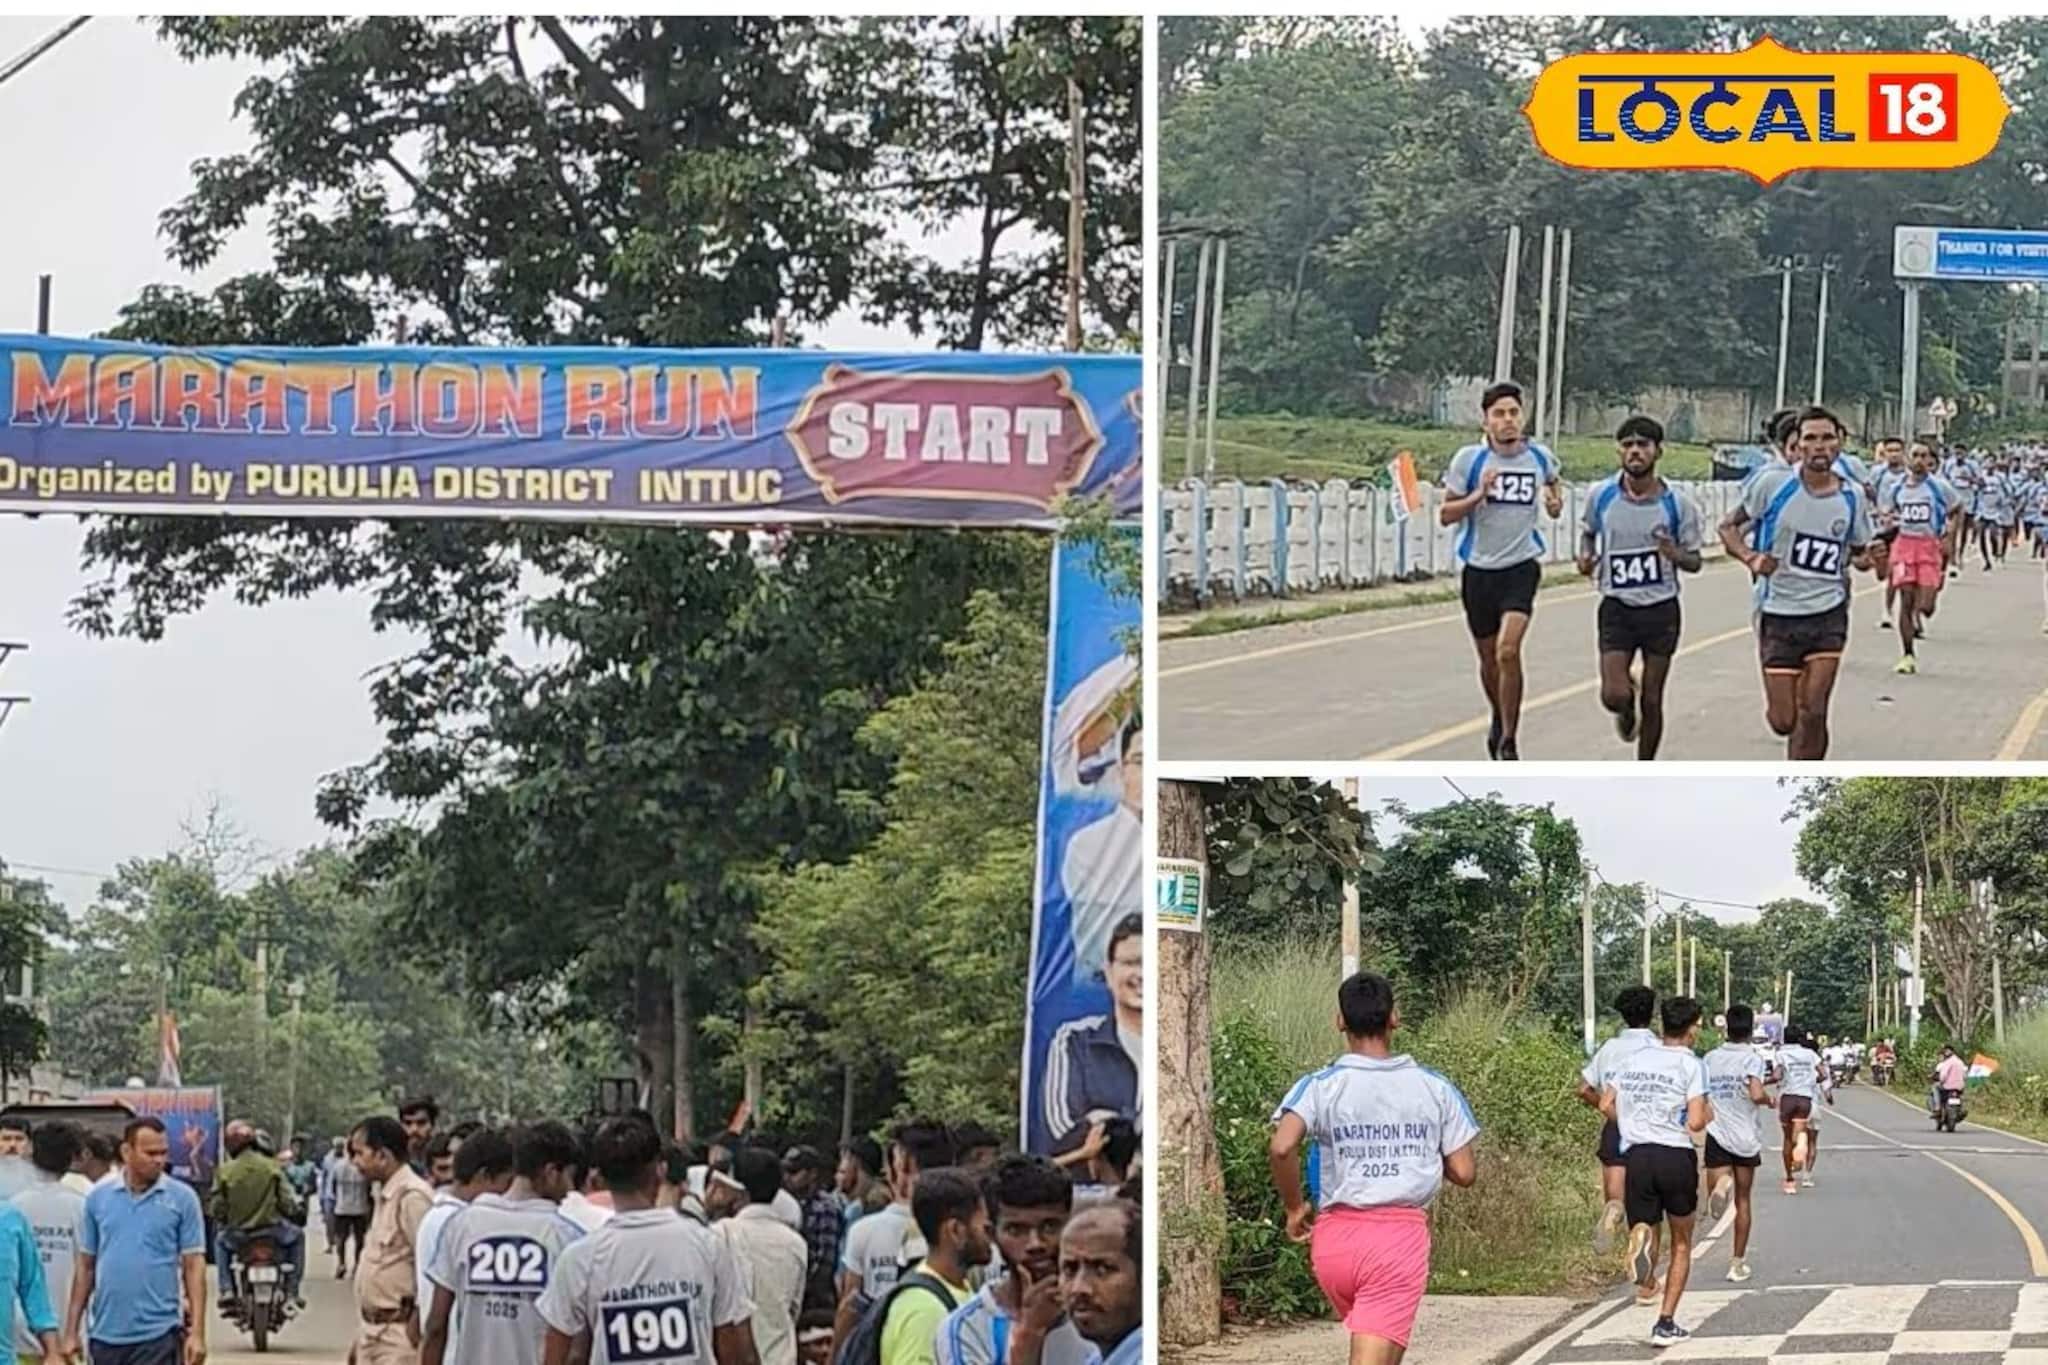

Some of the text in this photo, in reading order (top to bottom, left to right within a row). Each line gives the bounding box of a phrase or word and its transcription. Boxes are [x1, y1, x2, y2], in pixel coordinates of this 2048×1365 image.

[1989, 242, 2013, 256] FOR
[10, 351, 761, 441] MARATHON RUN
[827, 402, 1061, 464] START
[0, 457, 783, 504] Organized by PURULIA DISTRICT INTTUC
[1612, 554, 1659, 584] 341
[1795, 538, 1840, 571] 172
[1404, 1123, 1428, 1139] RUN
[1362, 1163, 1400, 1178] 2025
[471, 1243, 544, 1282] 202
[485, 1301, 519, 1320] 2025
[609, 1307, 689, 1355] 190
